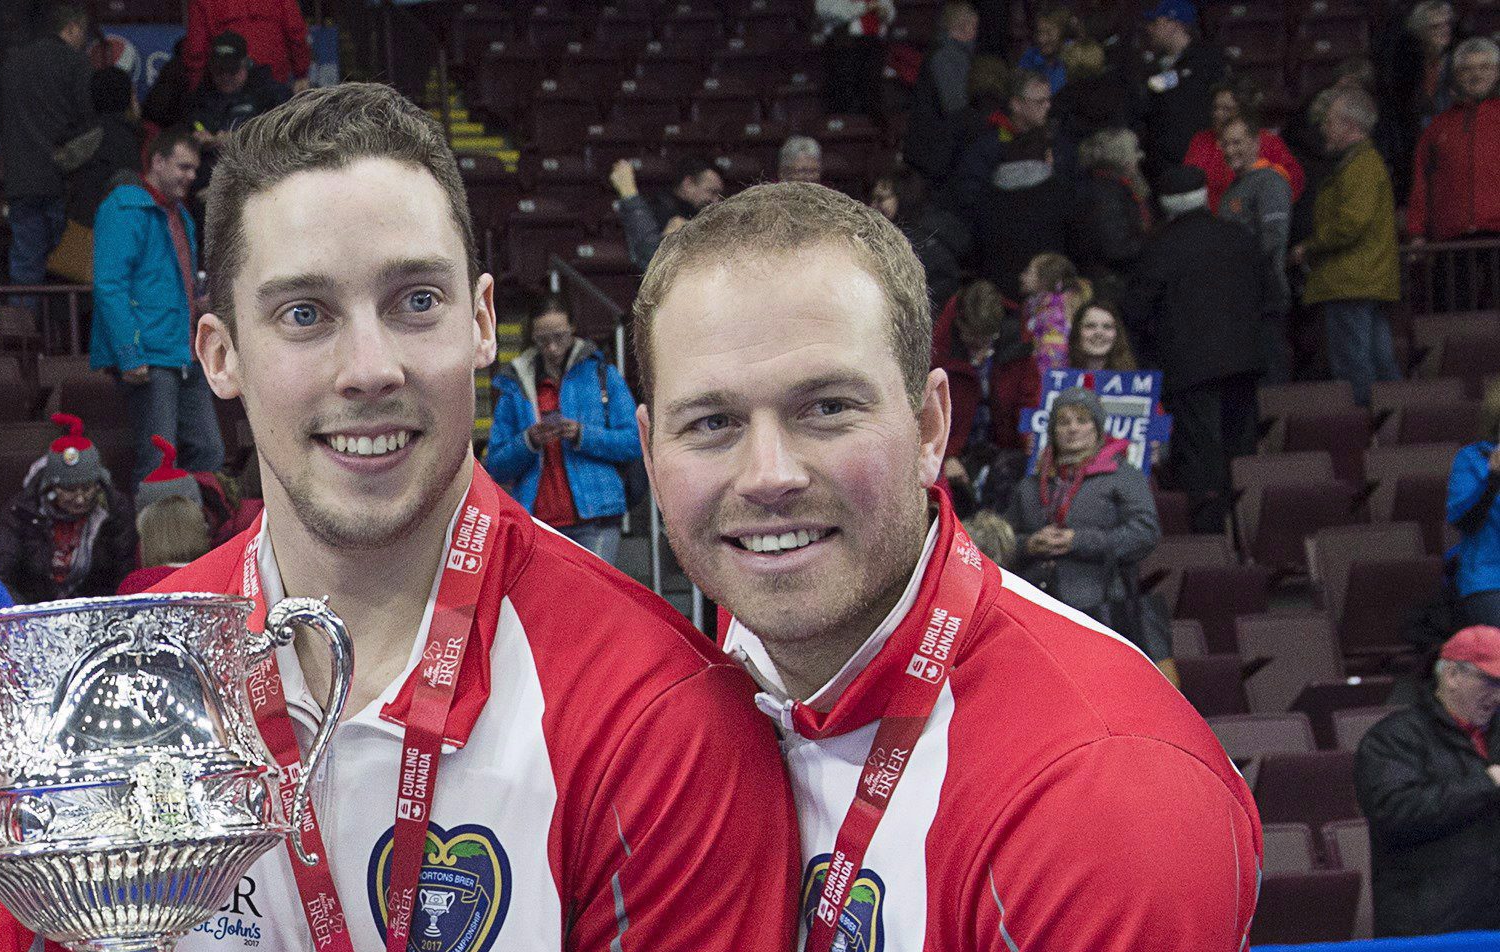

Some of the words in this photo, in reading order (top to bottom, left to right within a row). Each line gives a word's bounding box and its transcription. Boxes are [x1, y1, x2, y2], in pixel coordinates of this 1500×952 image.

[455, 504, 480, 549] CURLING
[469, 513, 492, 553] CANADA
[918, 607, 949, 656] CURLING
[933, 616, 962, 662] CANADA
[437, 635, 464, 688] BRIER
[401, 747, 420, 796] CURLING
[414, 752, 432, 799] CANADA
[876, 747, 909, 800] BRIER
[454, 872, 475, 887] BRIER
[824, 850, 846, 899] CURLING
[831, 860, 855, 905] CANADA
[214, 916, 261, 940] John's
[244, 939, 260, 947] 2017
[307, 900, 332, 949] BRIER
[421, 940, 442, 951] 2017
